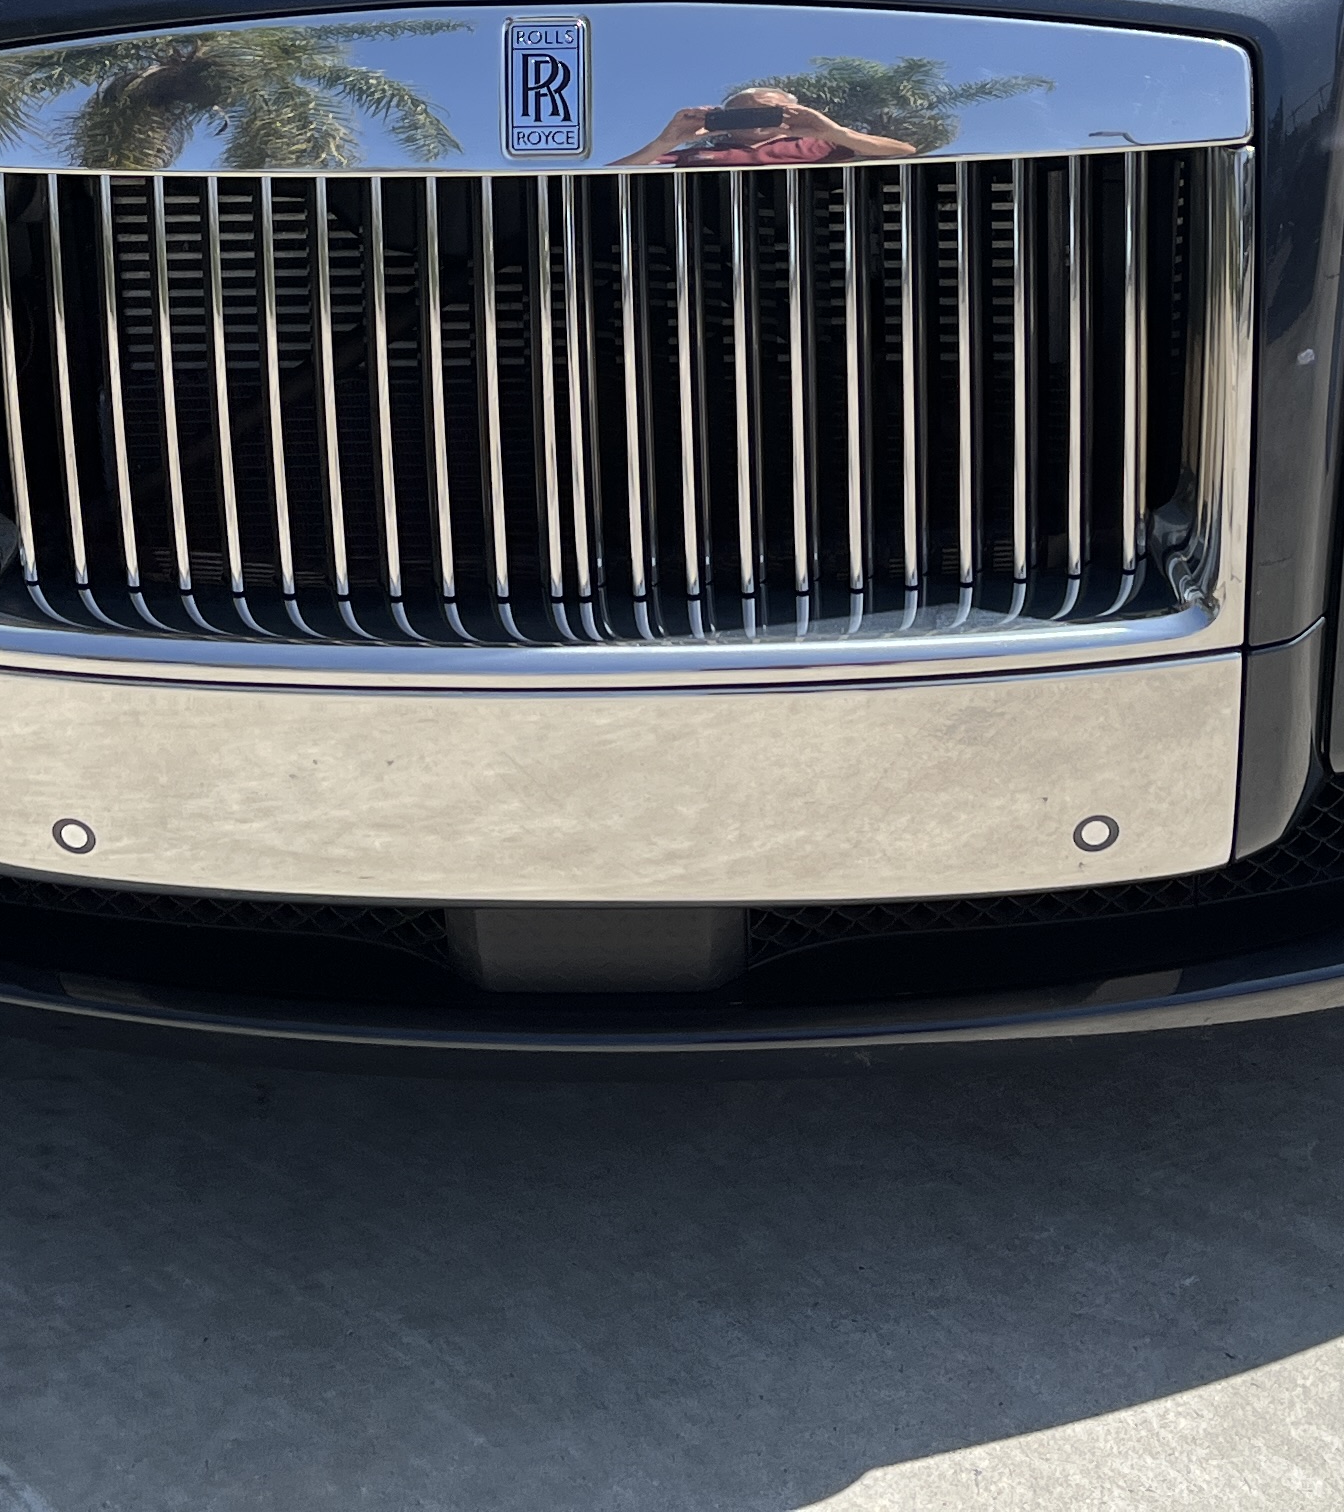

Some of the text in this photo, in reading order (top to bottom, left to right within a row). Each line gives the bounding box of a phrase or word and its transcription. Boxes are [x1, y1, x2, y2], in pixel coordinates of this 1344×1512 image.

[516, 30, 575, 45] ROLLS
[521, 53, 572, 123] RR
[516, 130, 575, 145] ROYCE
